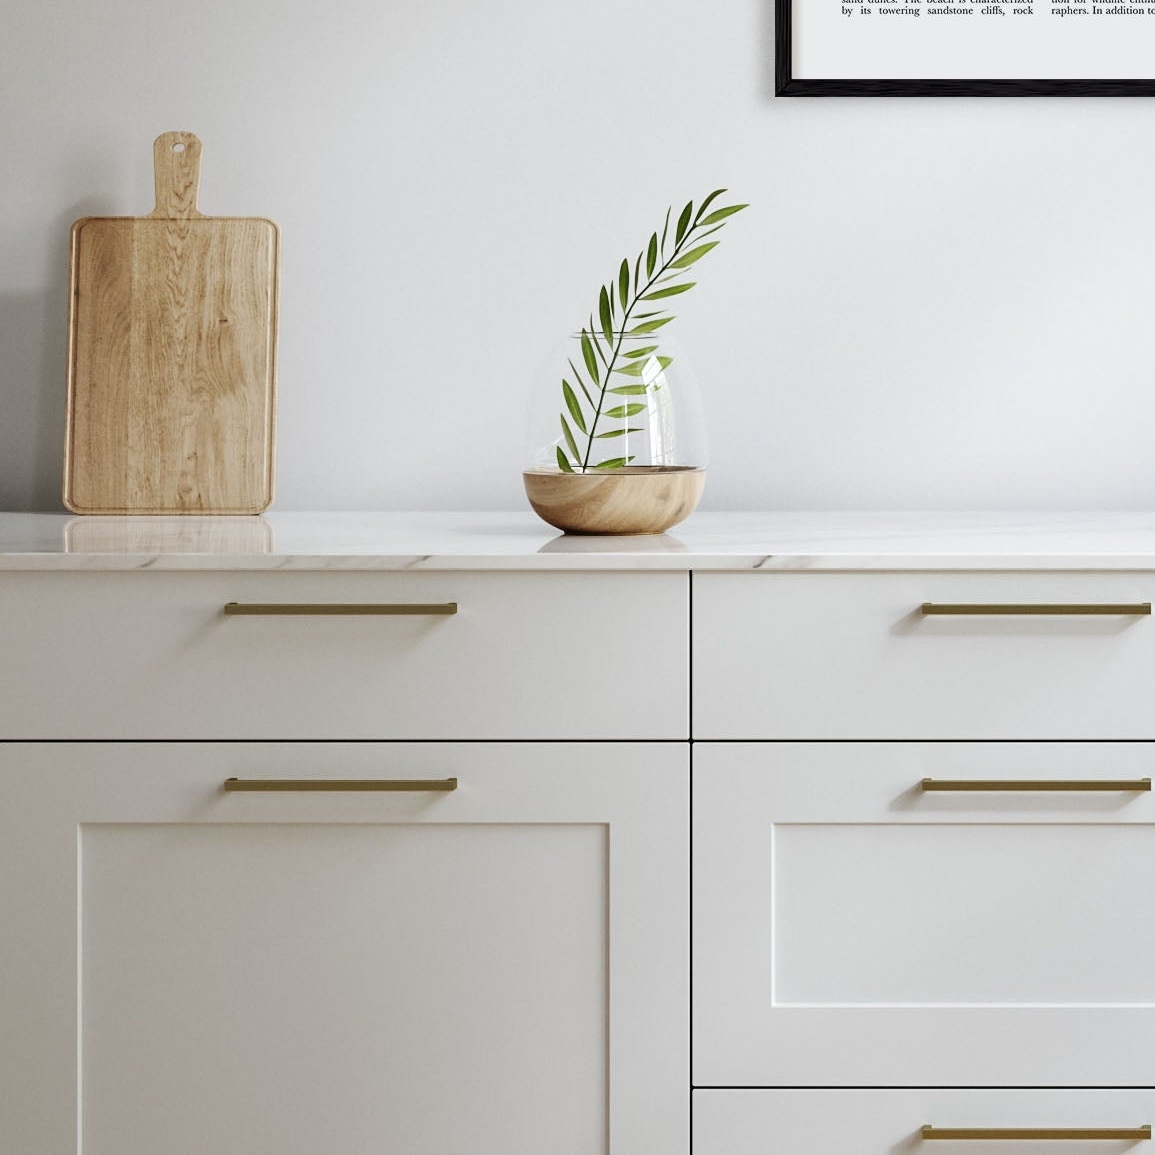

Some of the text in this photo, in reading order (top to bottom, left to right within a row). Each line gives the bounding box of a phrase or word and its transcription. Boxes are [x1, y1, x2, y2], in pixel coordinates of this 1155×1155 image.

[841, 5, 1034, 16] by its towering sandstone cliffs, rock
[1051, 5, 1090, 16] raphers.
[1092, 5, 1103, 14] In
[1105, 5, 1145, 14] addition
